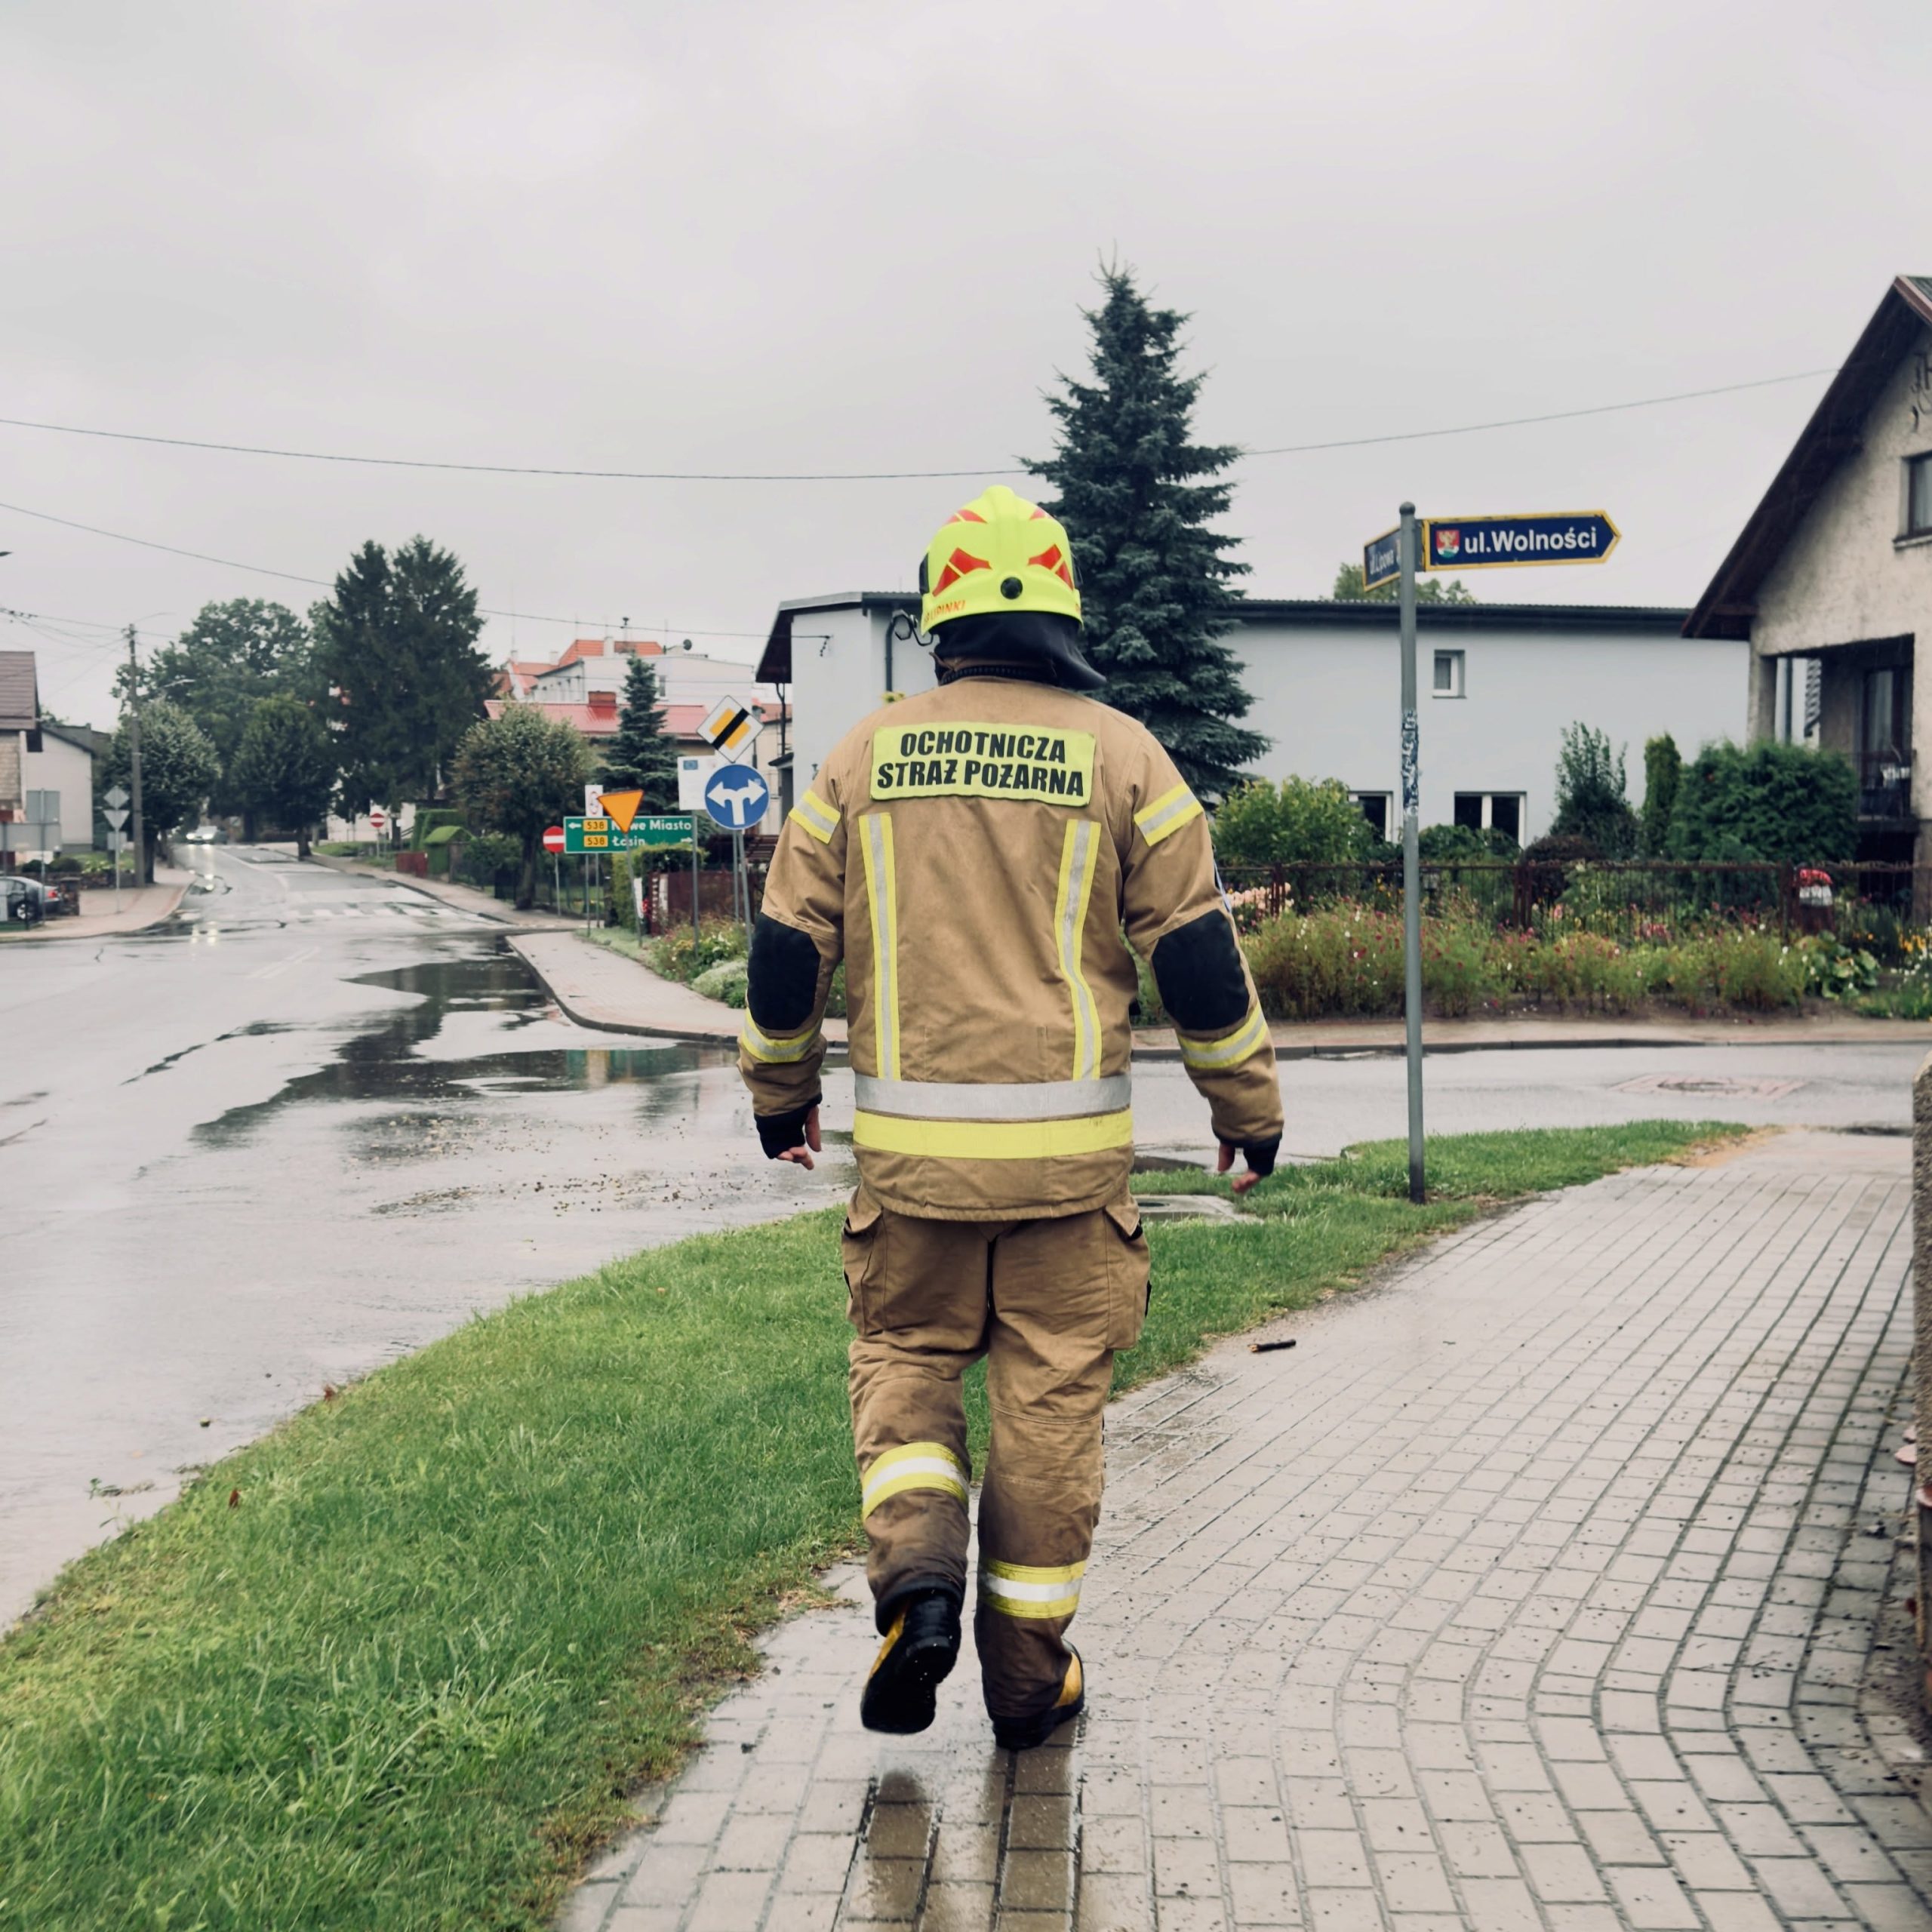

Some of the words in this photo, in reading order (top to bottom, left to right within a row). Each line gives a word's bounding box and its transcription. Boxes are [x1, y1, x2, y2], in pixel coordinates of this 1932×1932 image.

[1464, 526, 1597, 553] ul.Wolności
[900, 730, 1066, 764] OCHOTNICZA
[586, 820, 605, 830] 538
[611, 820, 646, 830] Nwe
[649, 819, 692, 831] Miasto
[586, 837, 605, 846] 538
